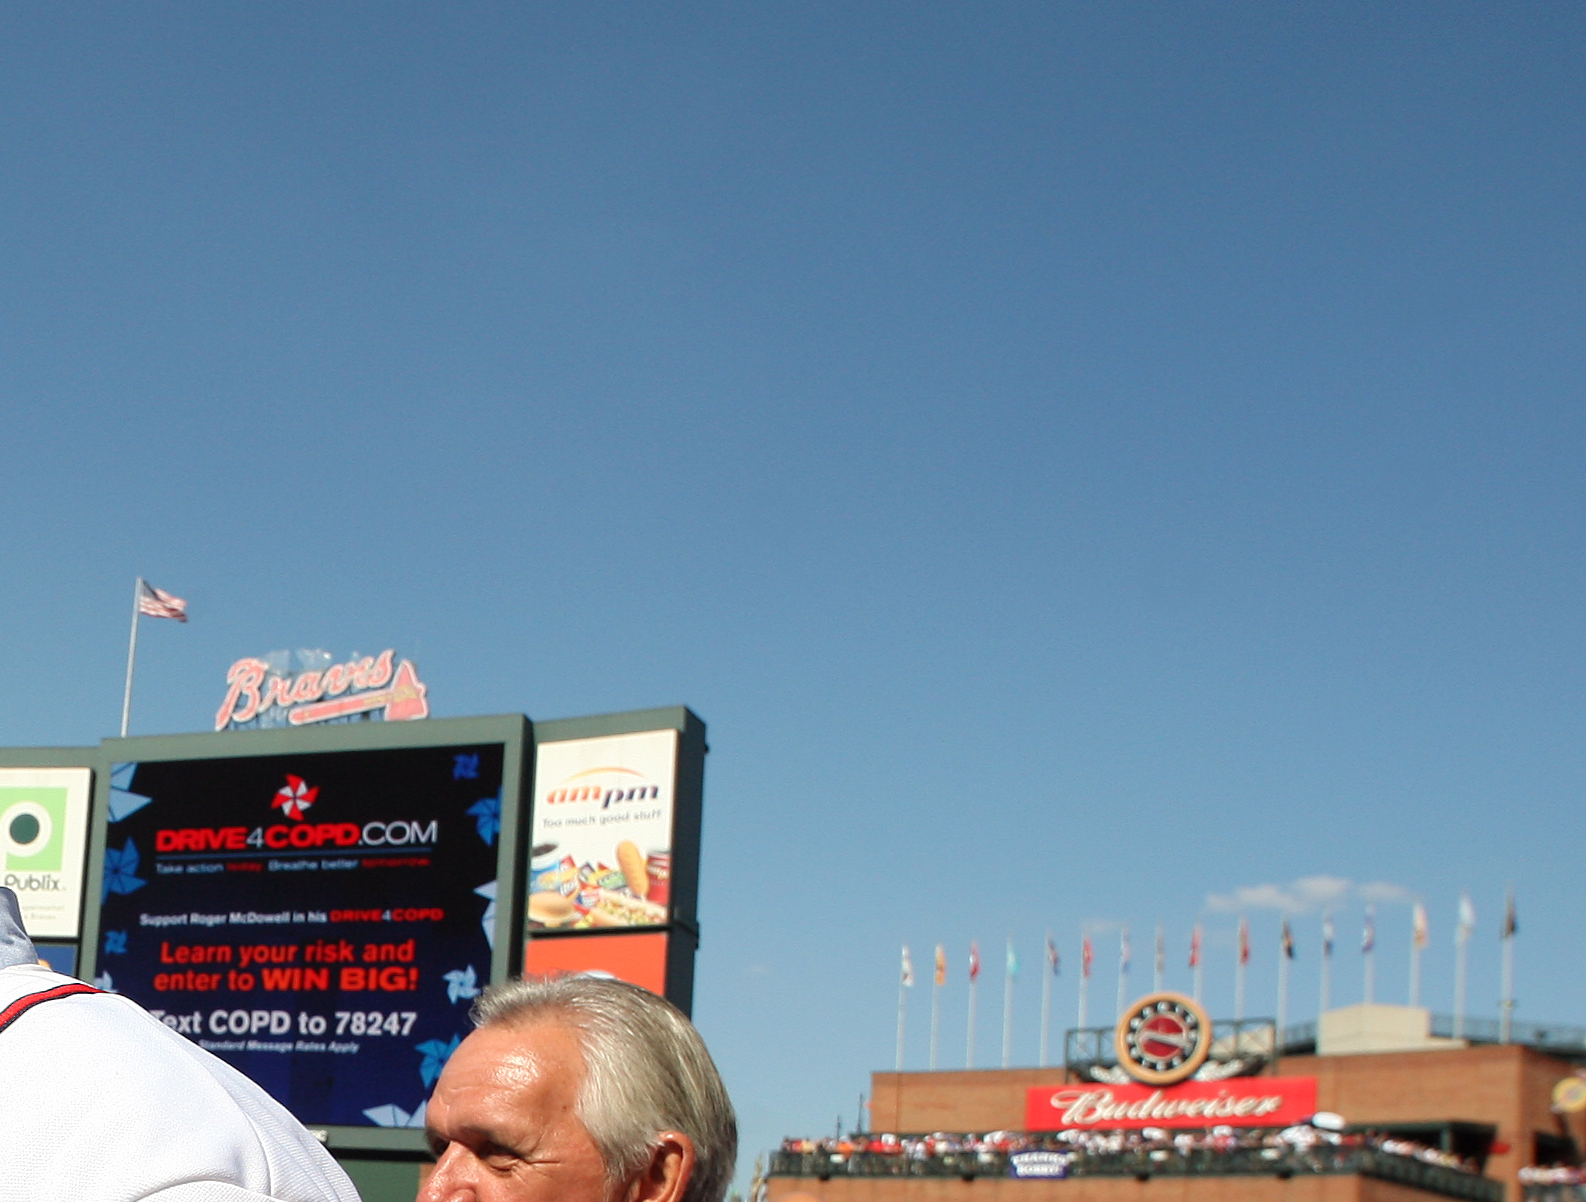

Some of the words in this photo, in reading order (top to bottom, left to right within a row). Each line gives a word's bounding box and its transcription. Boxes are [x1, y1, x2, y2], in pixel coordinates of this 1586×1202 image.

[215, 649, 395, 732] Braves
[155, 820, 438, 851] DRIVE4COPD.COM
[4, 873, 61, 891] Publix
[139, 912, 188, 928] Support
[190, 912, 227, 927] Roger
[229, 911, 290, 924] McDowell
[292, 911, 305, 923] in
[307, 910, 327, 923] his
[329, 908, 444, 922] DRIVE4COPD
[160, 942, 231, 964] Learn
[238, 945, 297, 968] your
[304, 940, 354, 963] risk
[362, 939, 415, 963] and
[153, 968, 222, 991] enter
[227, 970, 254, 991] to
[261, 968, 329, 991] WIN
[339, 966, 419, 991] BIG!
[208, 1009, 291, 1035] COPD
[298, 1012, 327, 1035] to
[335, 1010, 417, 1036] 78247
[246, 1040, 294, 1054] Message
[327, 1041, 360, 1054] Apply
[1050, 1089, 1282, 1126] Budweiser
